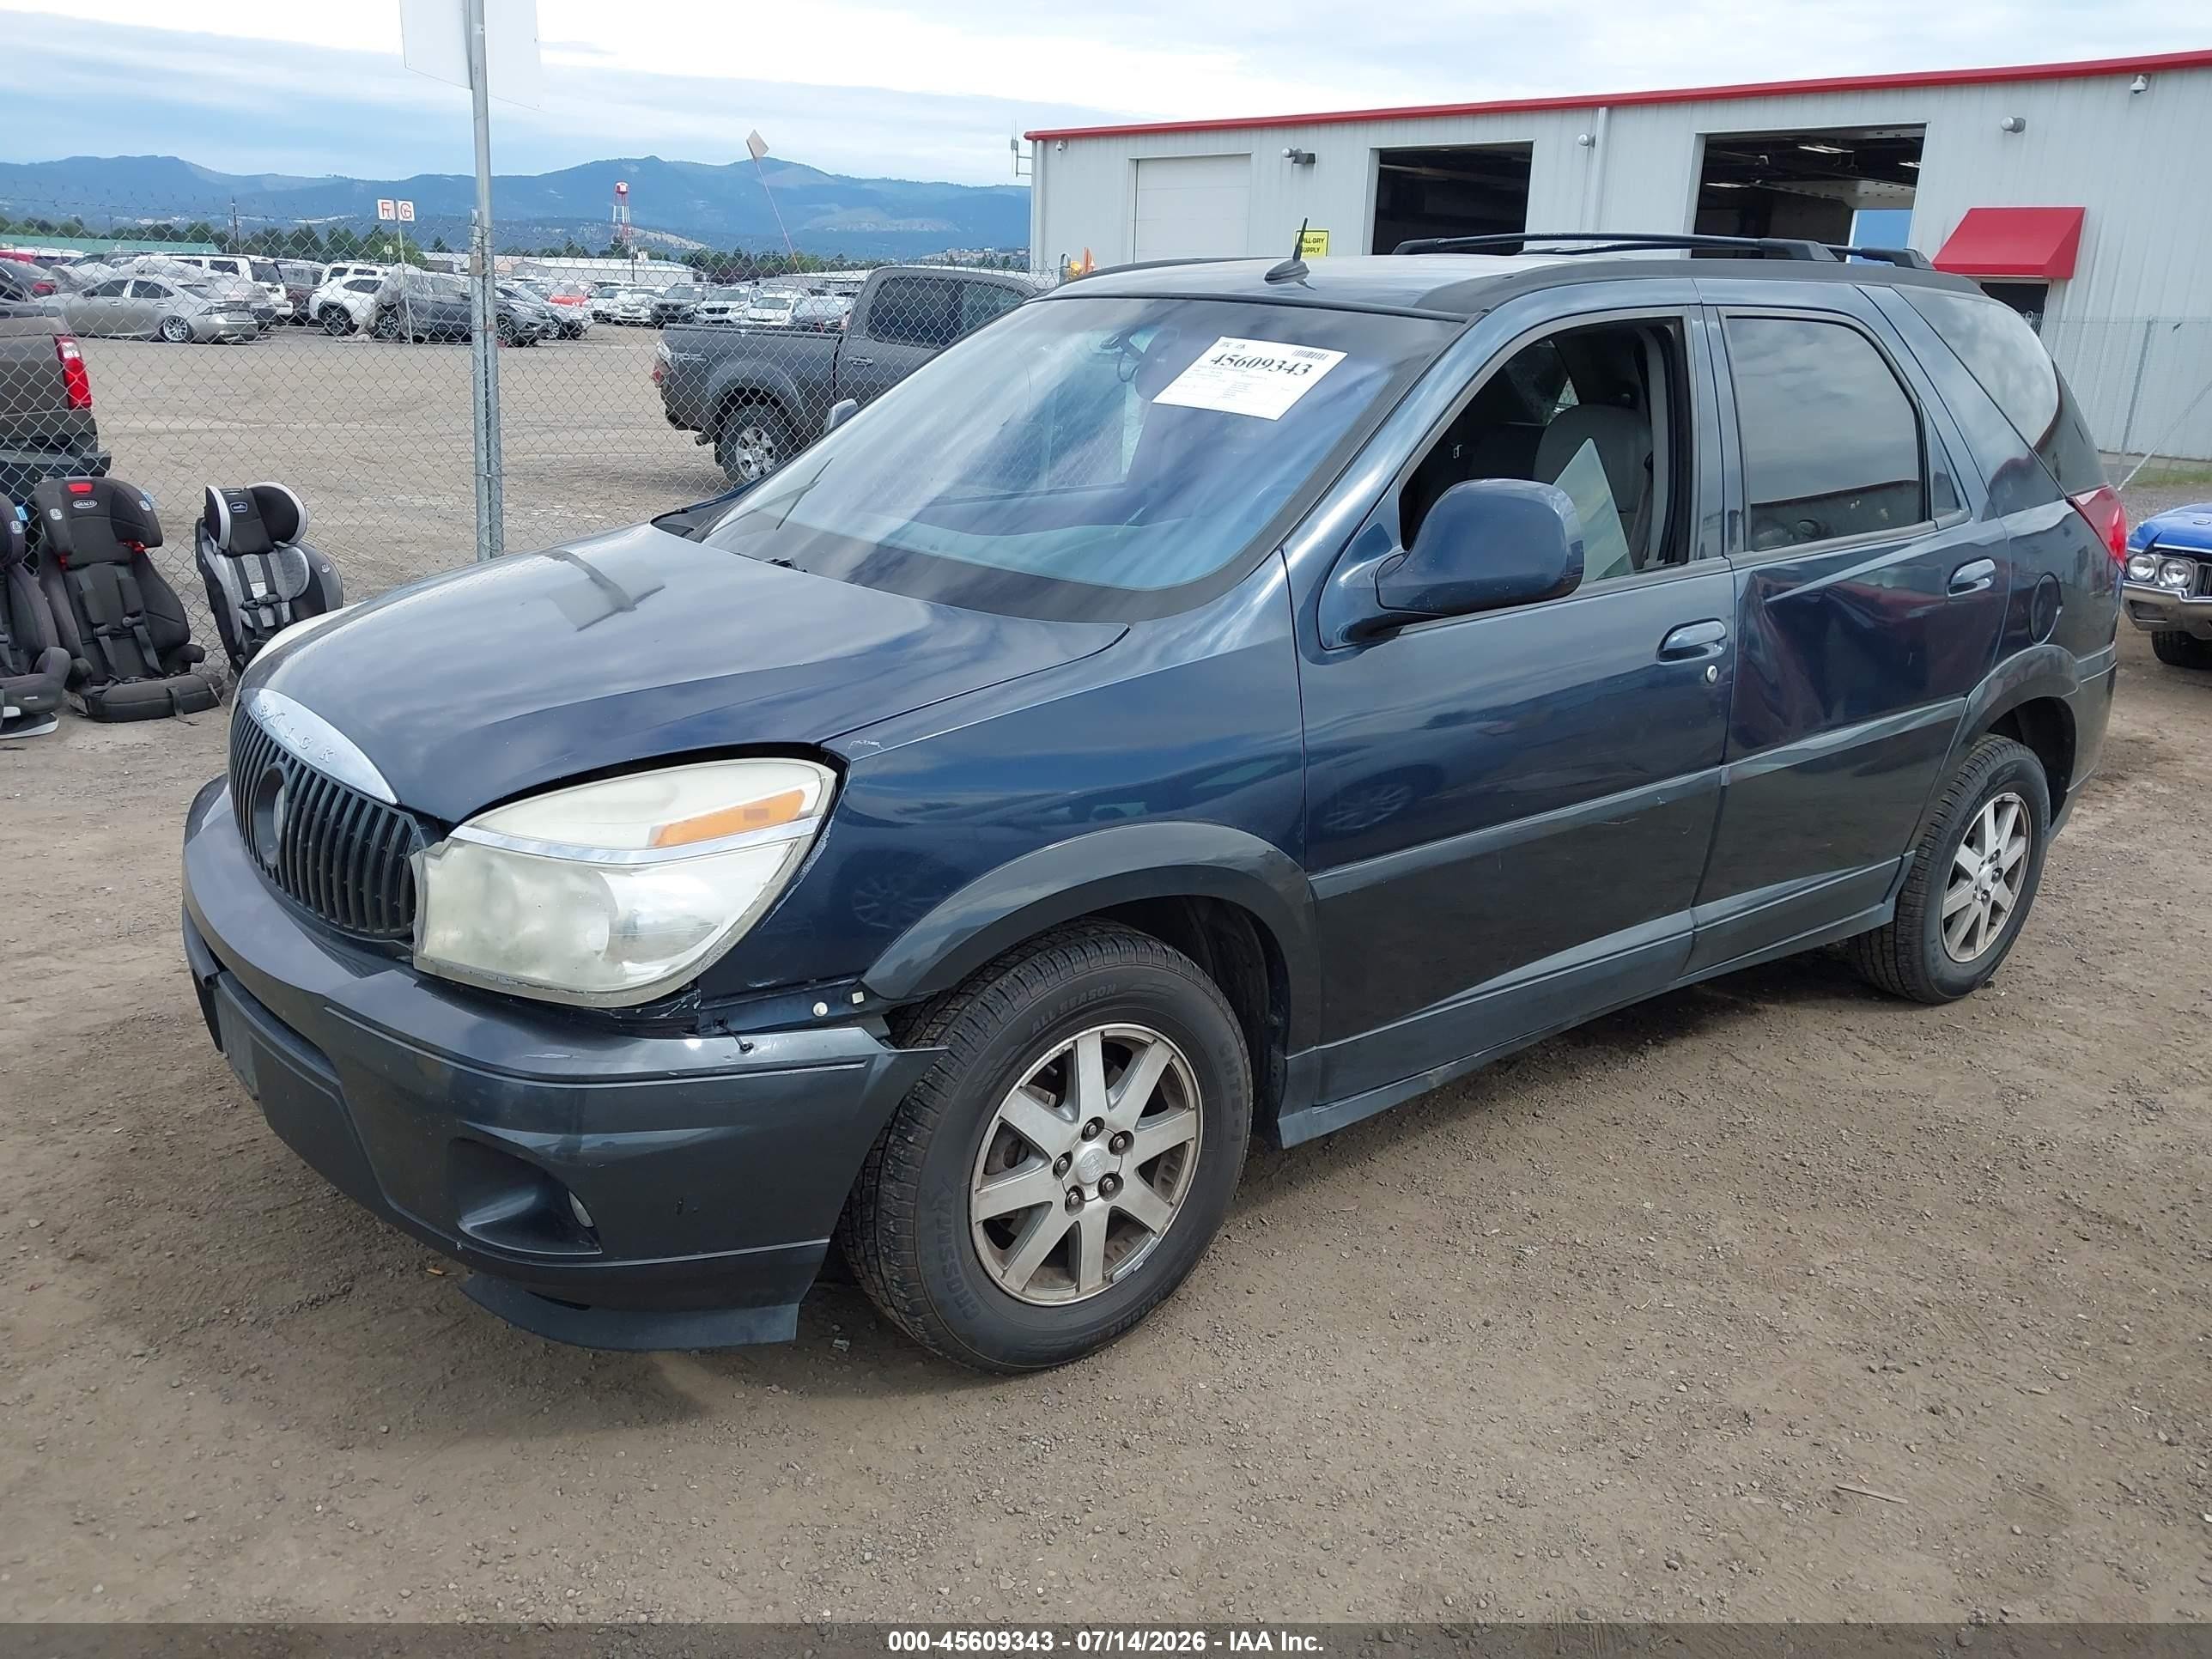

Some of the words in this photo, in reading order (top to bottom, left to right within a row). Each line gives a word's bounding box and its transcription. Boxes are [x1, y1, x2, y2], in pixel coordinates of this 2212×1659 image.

[400, 203, 412, 219] G
[1211, 353, 1313, 376] 45609343
[258, 703, 337, 763] BUICK
[1031, 1010, 1058, 1036] ALL
[1058, 983, 1117, 1014] SEASON
